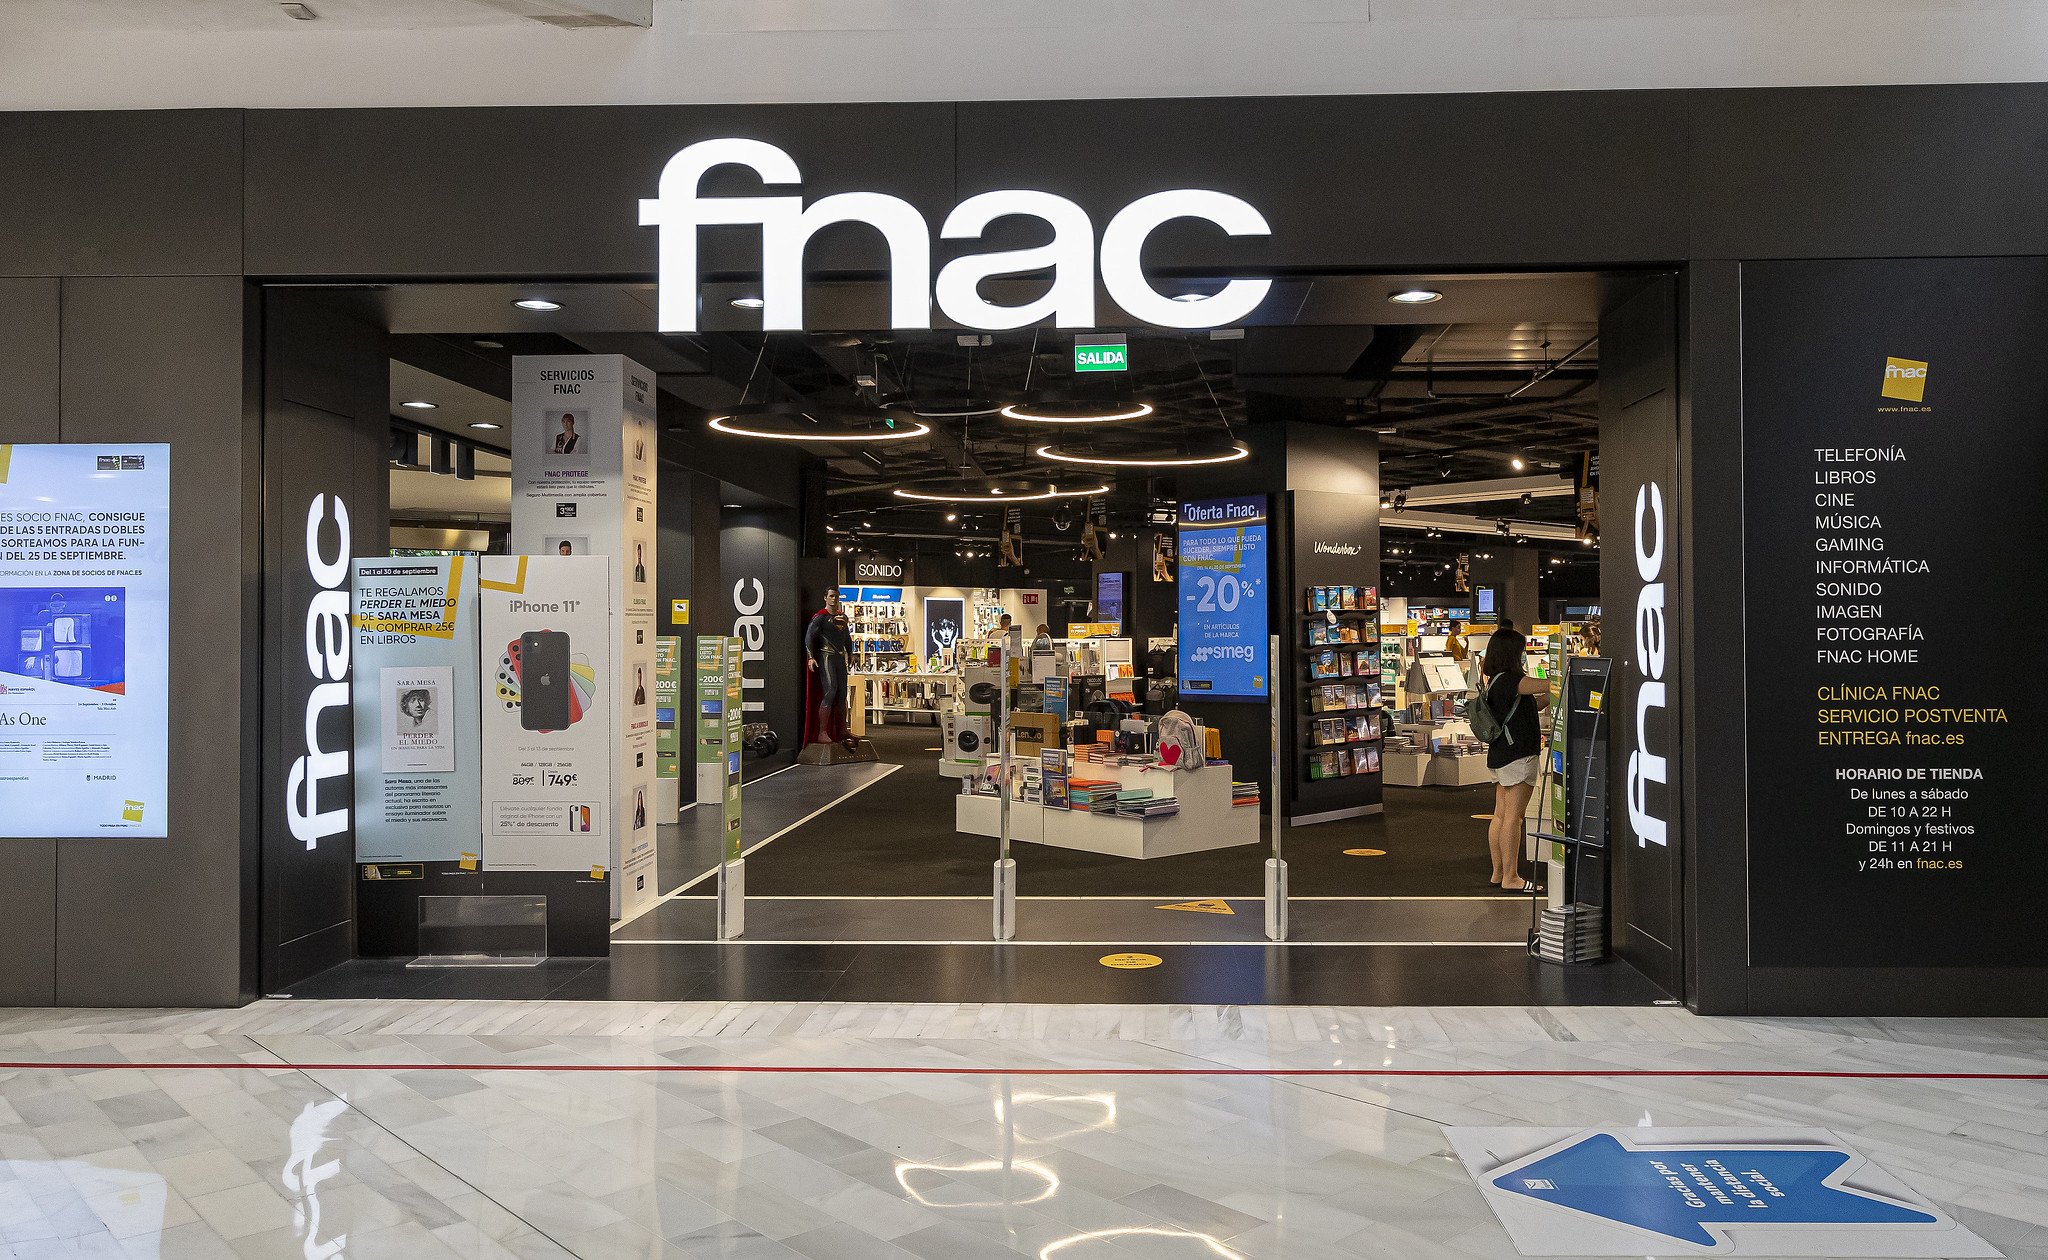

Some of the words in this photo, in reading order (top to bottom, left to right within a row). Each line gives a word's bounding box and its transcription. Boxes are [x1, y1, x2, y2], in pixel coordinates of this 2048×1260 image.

[638, 137, 1272, 332] fnac
[1077, 351, 1125, 365] SALIDA
[540, 370, 595, 381] SERVICIOS
[1885, 364, 1927, 379] fnac
[553, 383, 581, 394] FNAC
[1814, 445, 1906, 462] TELEFONÍA
[1815, 470, 1876, 485] LIBROS
[1815, 493, 1855, 507] CINE
[0, 512, 13, 522] ES
[16, 512, 51, 522] SOCIO
[54, 512, 85, 523] FNAC,
[88, 512, 145, 522] CONSIGUE
[1188, 505, 1223, 521] Oferta
[1226, 503, 1255, 518] Fnac
[1815, 513, 1882, 530] MÚSICA
[0, 526, 14, 535] DE
[16, 526, 35, 534] LAS
[37, 526, 44, 534] 5
[45, 525, 100, 534] ENTRADAS
[103, 525, 145, 534] DOBLES
[1, 538, 67, 548] SORTEAMOS
[70, 538, 98, 547] PARA
[102, 538, 115, 547] LA
[118, 538, 145, 547] FUN-
[1200, 537, 1217, 545] TODO
[1241, 534, 1262, 542] PUEDA
[1815, 537, 1884, 552] GAMING
[1238, 543, 1256, 551] LISTO
[6, 551, 25, 560] DEL
[28, 551, 40, 560] 25
[43, 551, 57, 560] DE
[60, 551, 126, 560] SEPTIEMBRE.
[401, 568, 436, 576] septiembre
[858, 563, 902, 577] SONIDO
[1816, 557, 1930, 574] INFORMÁTICA
[360, 588, 372, 597] TE
[375, 587, 444, 597] REGALAMOS
[1816, 582, 1882, 597] SONIDO
[360, 599, 402, 609] PERDER
[404, 599, 416, 608] EL
[419, 598, 457, 608] MIEDO
[509, 600, 559, 613] iPhone
[360, 612, 375, 621] DE
[377, 611, 407, 621] SARA
[410, 610, 441, 620] MESA
[1816, 604, 1882, 619] IMAGEN
[360, 623, 373, 633] AL
[376, 622, 433, 632] COMPRAR
[435, 622, 455, 632] 25€
[1211, 622, 1240, 630] ARTÍCULOS
[1816, 624, 1924, 641] FOTOGRAFÍA
[360, 636, 374, 645] EN
[377, 635, 416, 644] LIBROS
[733, 577, 765, 712] nac
[1213, 645, 1254, 663] smeg
[1817, 649, 1862, 664] FNAC
[1867, 649, 1918, 664] HOME
[286, 492, 350, 851] fnac
[1627, 481, 1667, 849] fnac
[1817, 683, 1888, 701] CLÍNICA
[1892, 685, 1940, 701] FNAC
[0, 712, 15, 726] As
[19, 711, 47, 726] One
[1817, 708, 1899, 724] SERVICIO
[1904, 708, 2008, 724] POSTVENTA
[1818, 731, 1901, 746] ENTREGA
[1905, 730, 1965, 745] fnac.es
[547, 773, 578, 786] 749€
[1835, 768, 1902, 780] HORARIO
[1906, 768, 1926, 780] DE
[1929, 768, 1983, 780] TIENDA
[1850, 788, 1869, 800] De
[1872, 788, 1906, 800] lunes
[1909, 791, 1917, 800] a
[1920, 788, 1969, 800] sábado
[1868, 806, 1887, 818] DE
[1890, 806, 1905, 818] 10
[1909, 806, 1919, 818] A
[1922, 806, 1938, 818] 22
[1941, 806, 1951, 818] H
[1846, 823, 1911, 837] Domingos
[1914, 826, 1922, 837] y
[1925, 823, 1975, 835] festivos
[1868, 841, 1887, 852] DE
[1891, 841, 1905, 852] 11
[1909, 841, 1919, 852] A
[1922, 841, 1937, 852] 21
[1942, 841, 1952, 852] H
[1858, 860, 1866, 872] y
[1869, 858, 1894, 870] 24h
[1897, 860, 1913, 870] en
[1916, 857, 1963, 870] fnac.es
[1649, 1160, 1679, 1176] por
[1680, 1163, 1735, 1206] mantener
[1703, 1159, 1756, 1199] distancia
[1741, 1169, 1787, 1198] social.
[1666, 1175, 1707, 1208] Gracias
[1748, 1198, 1768, 1208] la
